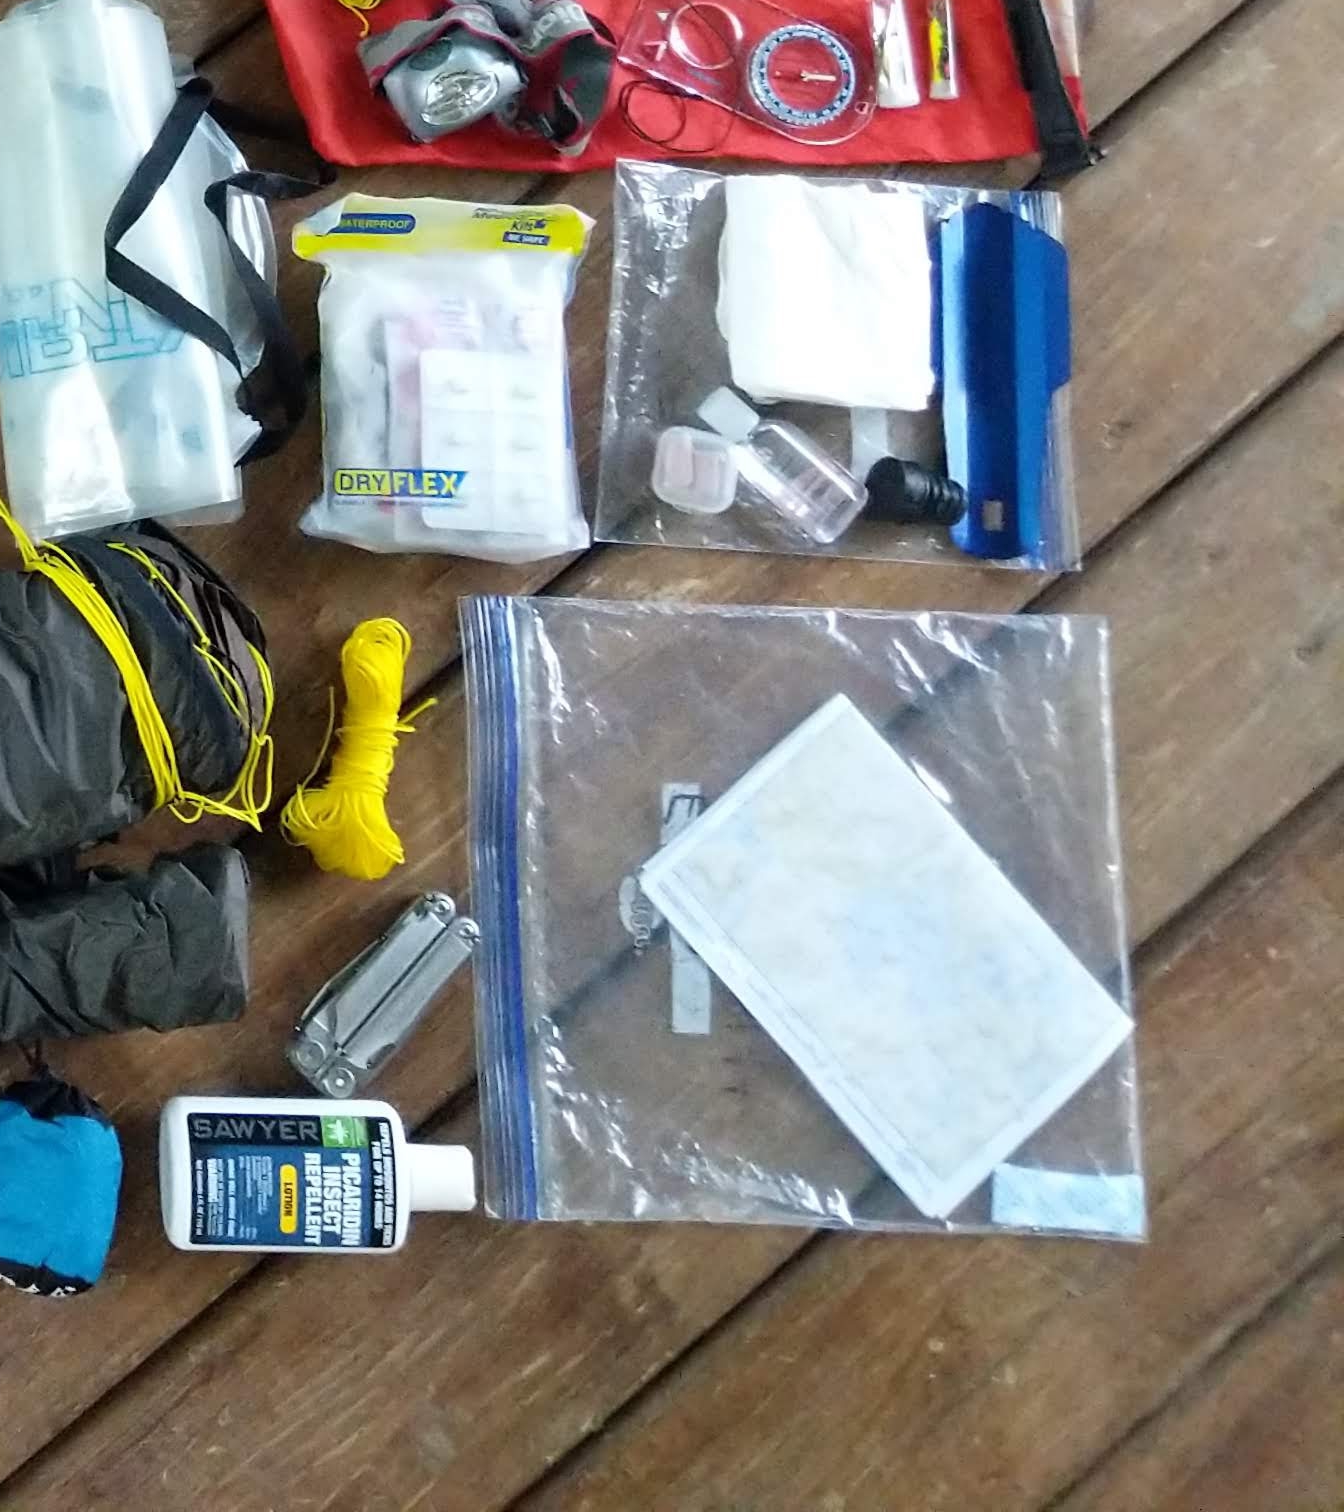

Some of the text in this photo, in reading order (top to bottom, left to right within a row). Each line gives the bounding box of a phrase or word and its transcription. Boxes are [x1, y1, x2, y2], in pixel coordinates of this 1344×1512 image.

[192, 1118, 320, 1141] SAWYER
[284, 1182, 293, 1217] LOTION
[304, 1152, 322, 1245] REPELLENT
[322, 1165, 342, 1235] INSECT
[341, 1152, 362, 1246] PICARIDIN
